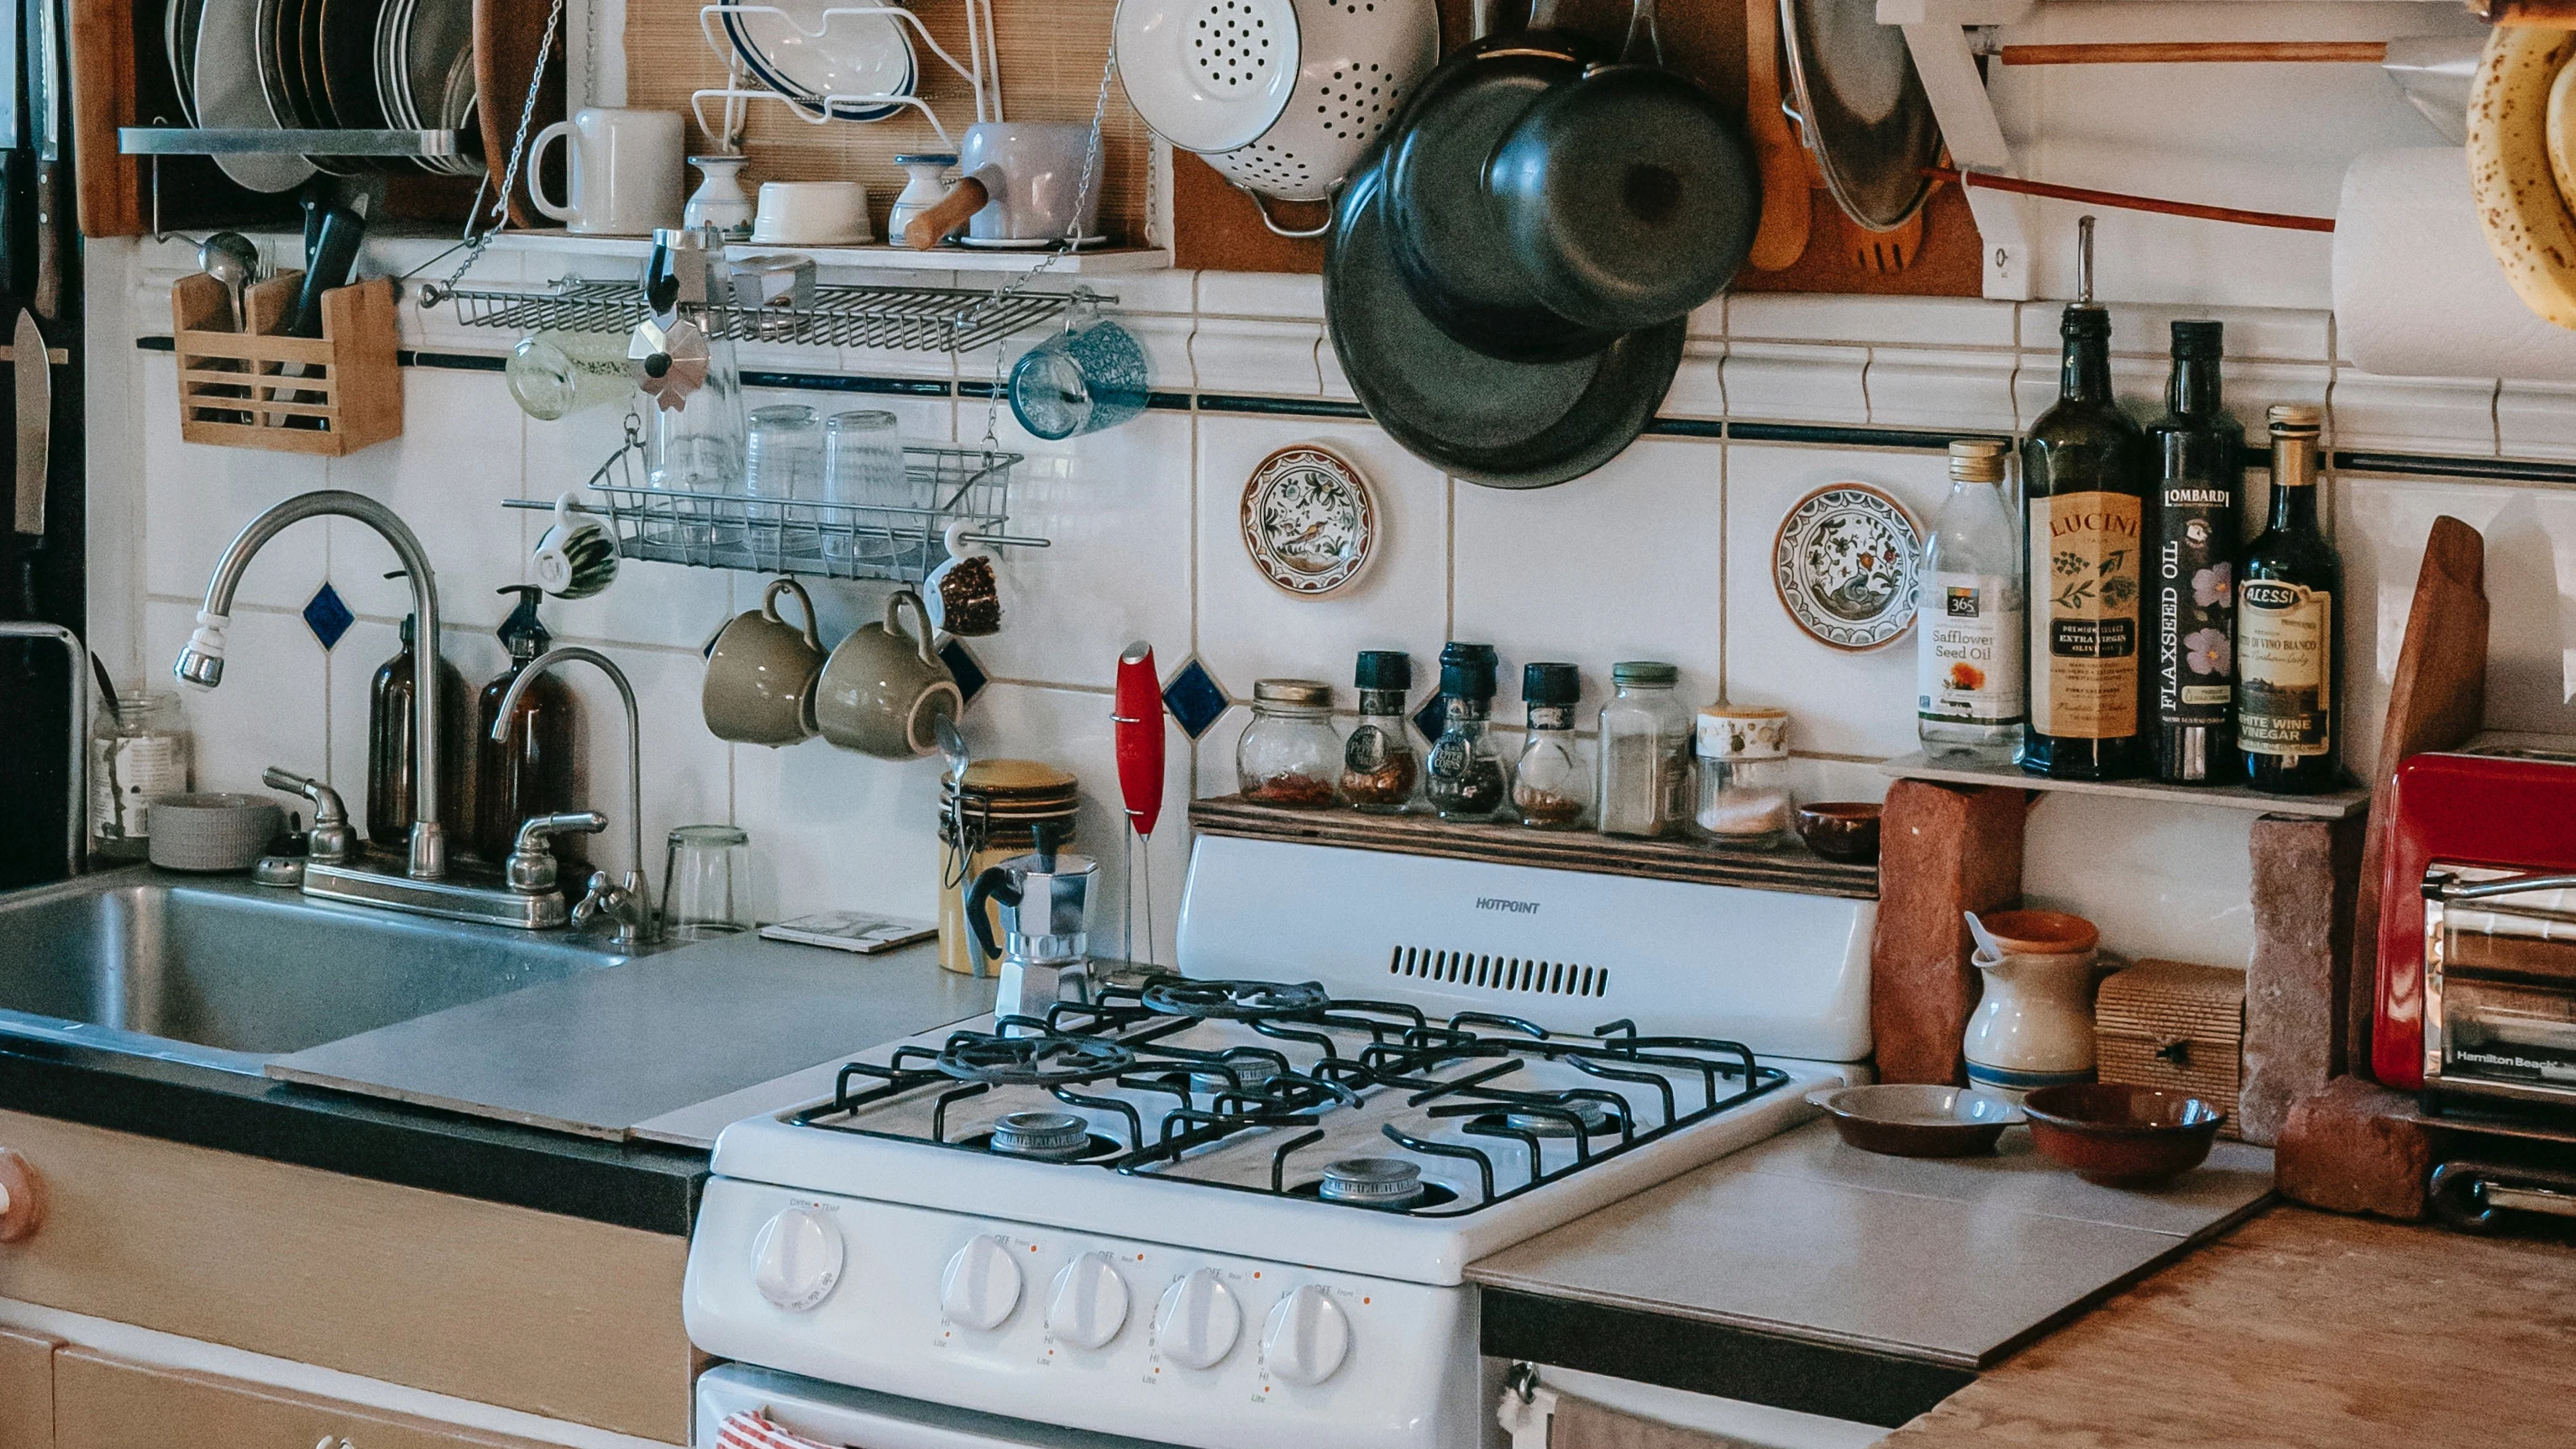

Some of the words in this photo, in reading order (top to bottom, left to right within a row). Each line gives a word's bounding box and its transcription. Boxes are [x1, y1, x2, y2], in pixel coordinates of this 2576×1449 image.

[2164, 489, 2229, 507] LOMBARDI
[2049, 512, 2137, 538] LUCINI
[2162, 540, 2179, 579] OIL
[2247, 587, 2295, 604] ALESSI
[1951, 597, 1975, 612] 365
[1933, 630, 1996, 646] Safflower
[2059, 634, 2094, 643] EXTRA
[2261, 639, 2281, 649] VINO
[2283, 641, 2316, 651] BIANCO
[1935, 646, 1966, 659] Seed
[1970, 648, 1991, 660] Oil
[2160, 587, 2178, 711] FLAXSEED
[2273, 719, 2312, 730] WINE
[2242, 726, 2301, 741] VINEGAR
[1476, 897, 1540, 915] HOTPOINT
[2457, 1050, 2514, 1067] Hamilton
[1099, 1251, 1115, 1261] OFF
[1314, 1284, 1331, 1294] OFF
